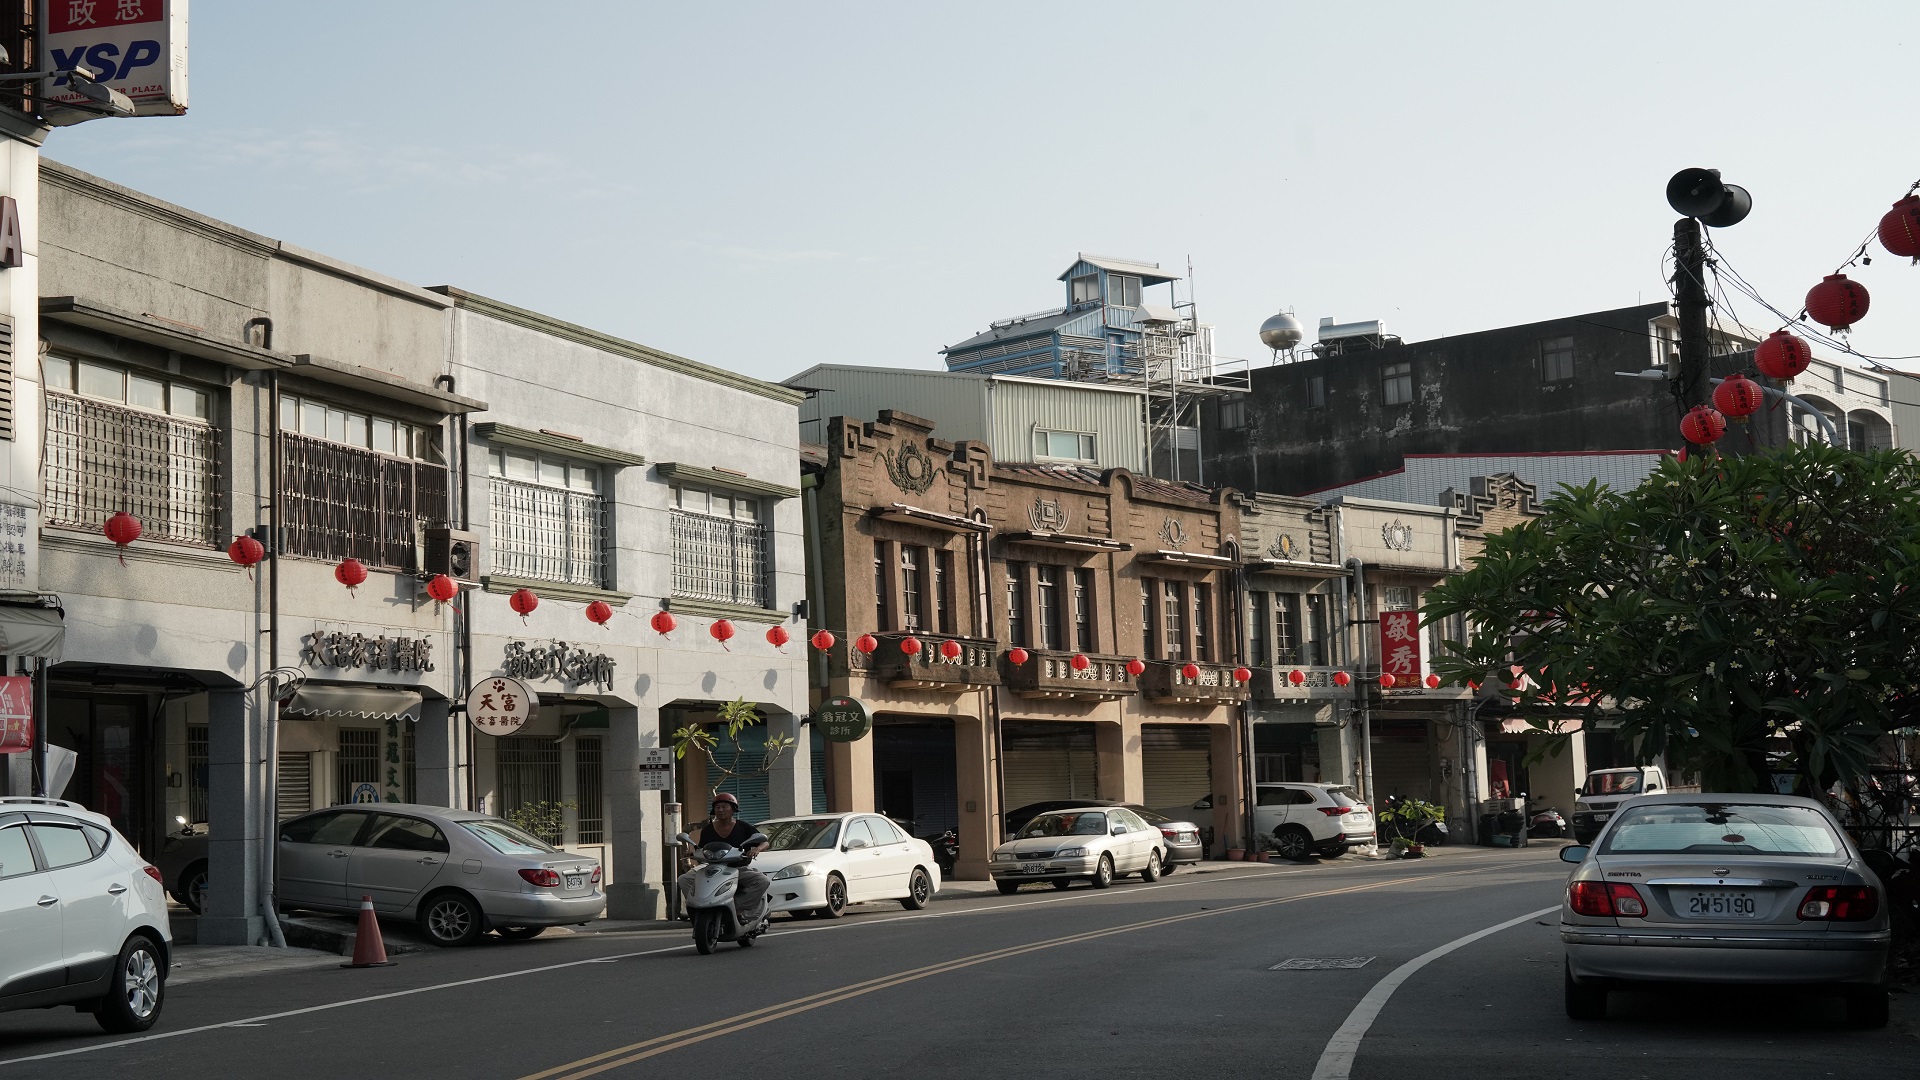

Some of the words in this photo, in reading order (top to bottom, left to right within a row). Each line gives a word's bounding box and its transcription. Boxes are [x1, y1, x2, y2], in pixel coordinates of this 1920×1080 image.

[50, 40, 161, 86] YSP
[49, 93, 85, 102] YAMAH
[131, 84, 164, 94] PLAZA
[0, 195, 22, 268] A
[310, 629, 436, 673] 天富家畜醫院
[1385, 613, 1418, 675] 敏秀
[478, 693, 518, 712] 天富
[475, 715, 522, 727] 家畜醫院
[821, 711, 861, 723] 翁冠文
[830, 726, 851, 736] 診所
